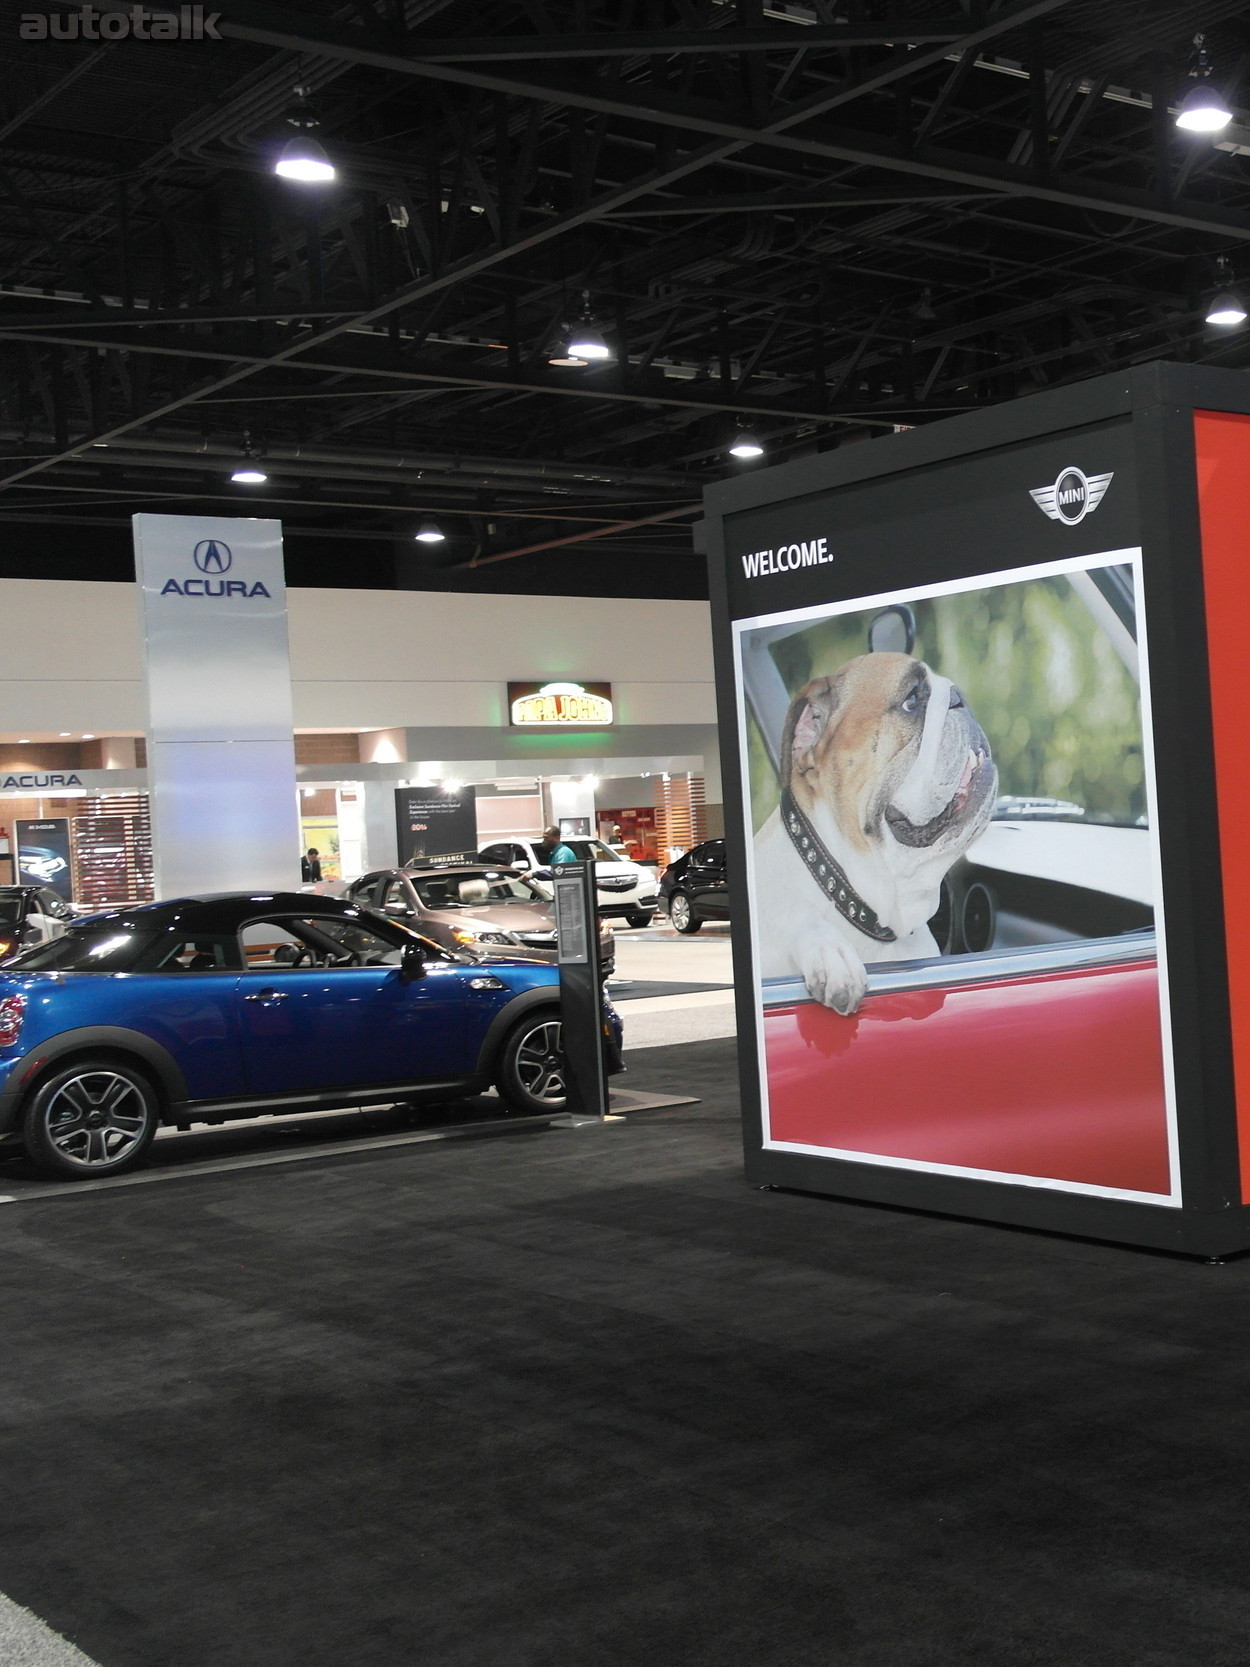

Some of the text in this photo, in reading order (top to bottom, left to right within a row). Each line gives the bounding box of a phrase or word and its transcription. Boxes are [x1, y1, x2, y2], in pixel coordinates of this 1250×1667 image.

[1058, 487, 1086, 506] MINI
[741, 537, 834, 580] WELCOME.
[160, 578, 272, 598] ACURA
[3, 774, 83, 788] ACURA
[429, 854, 465, 864] SUNDANCE
